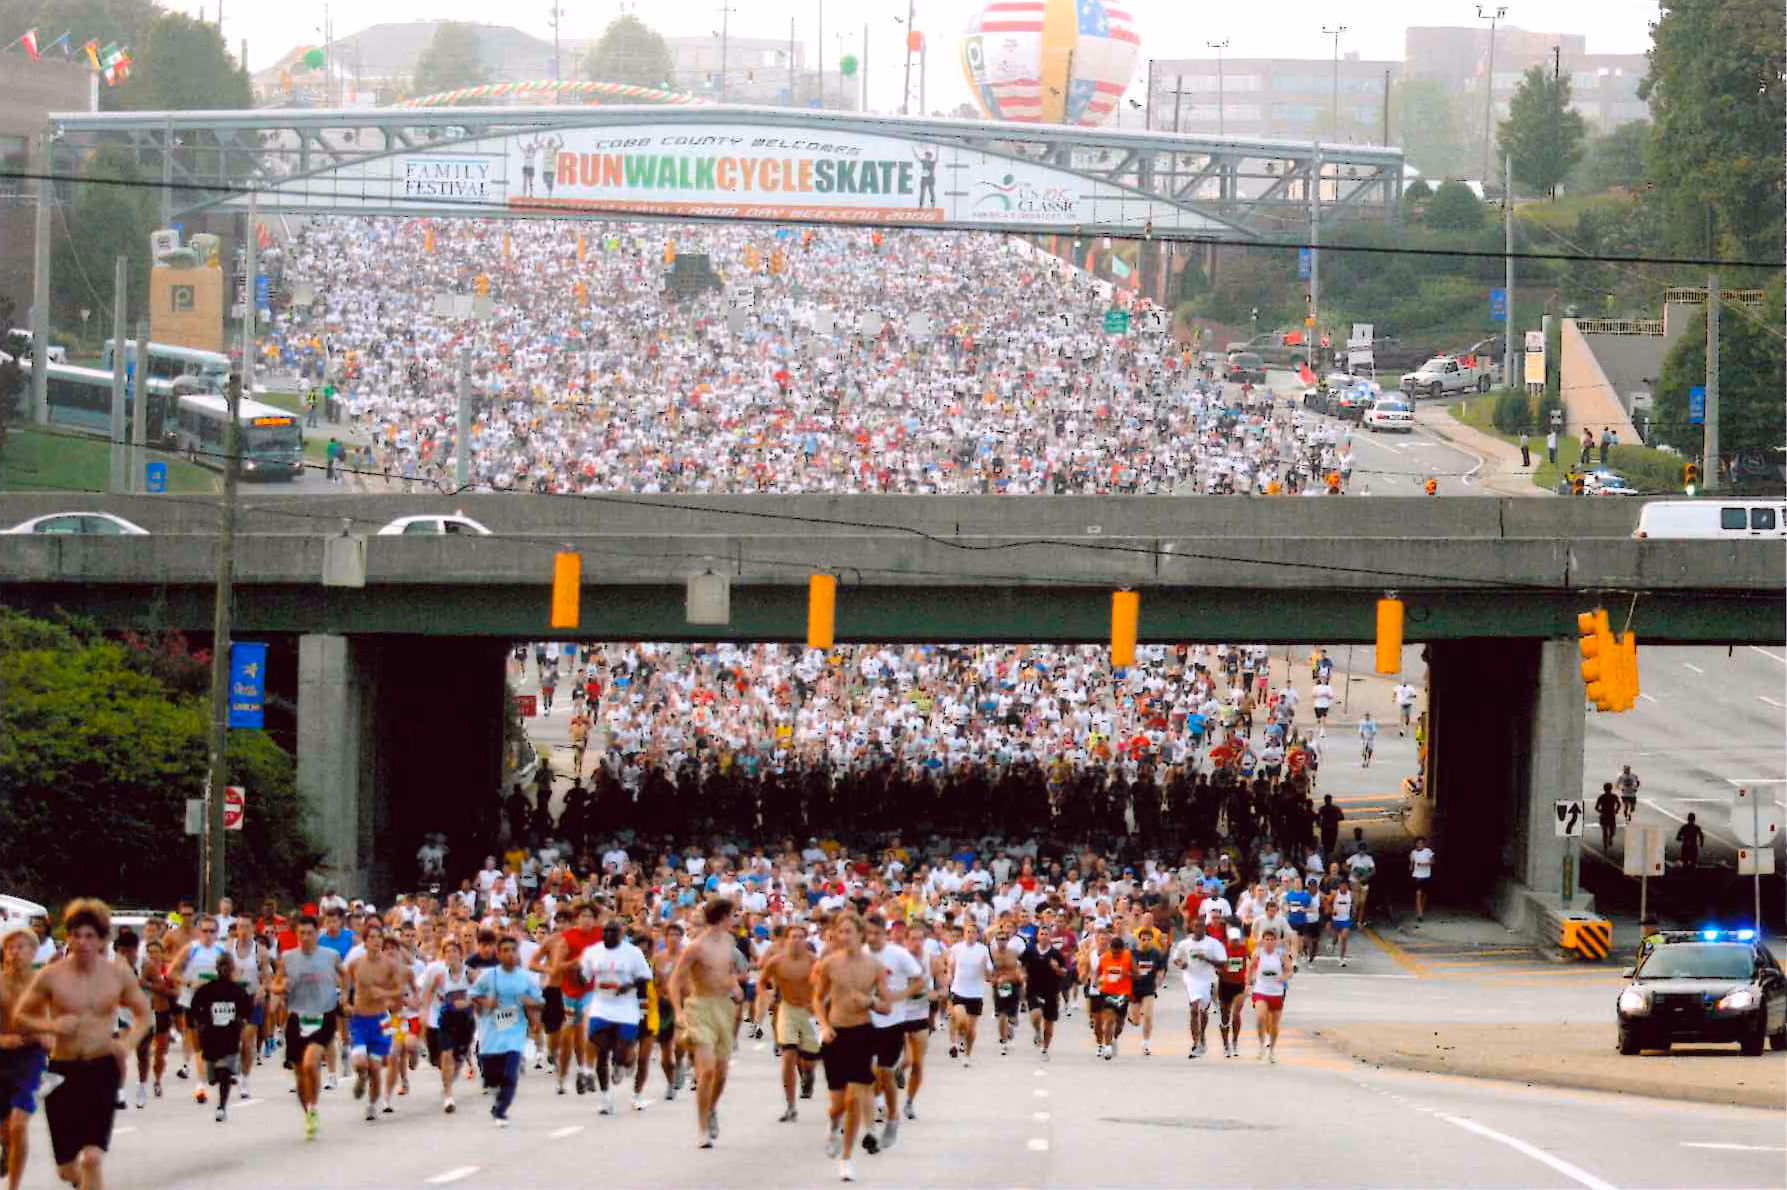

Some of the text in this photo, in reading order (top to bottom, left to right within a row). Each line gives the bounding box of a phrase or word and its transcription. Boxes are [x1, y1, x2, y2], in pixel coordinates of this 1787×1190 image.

[595, 136, 863, 156] COBB COUNTY WELCOMES
[407, 163, 489, 179] FAMILY
[406, 180, 489, 196] FESTIVAL
[745, 207, 785, 217] DAY
[790, 209, 879, 220] WEEKEND
[886, 210, 936, 221] 2006
